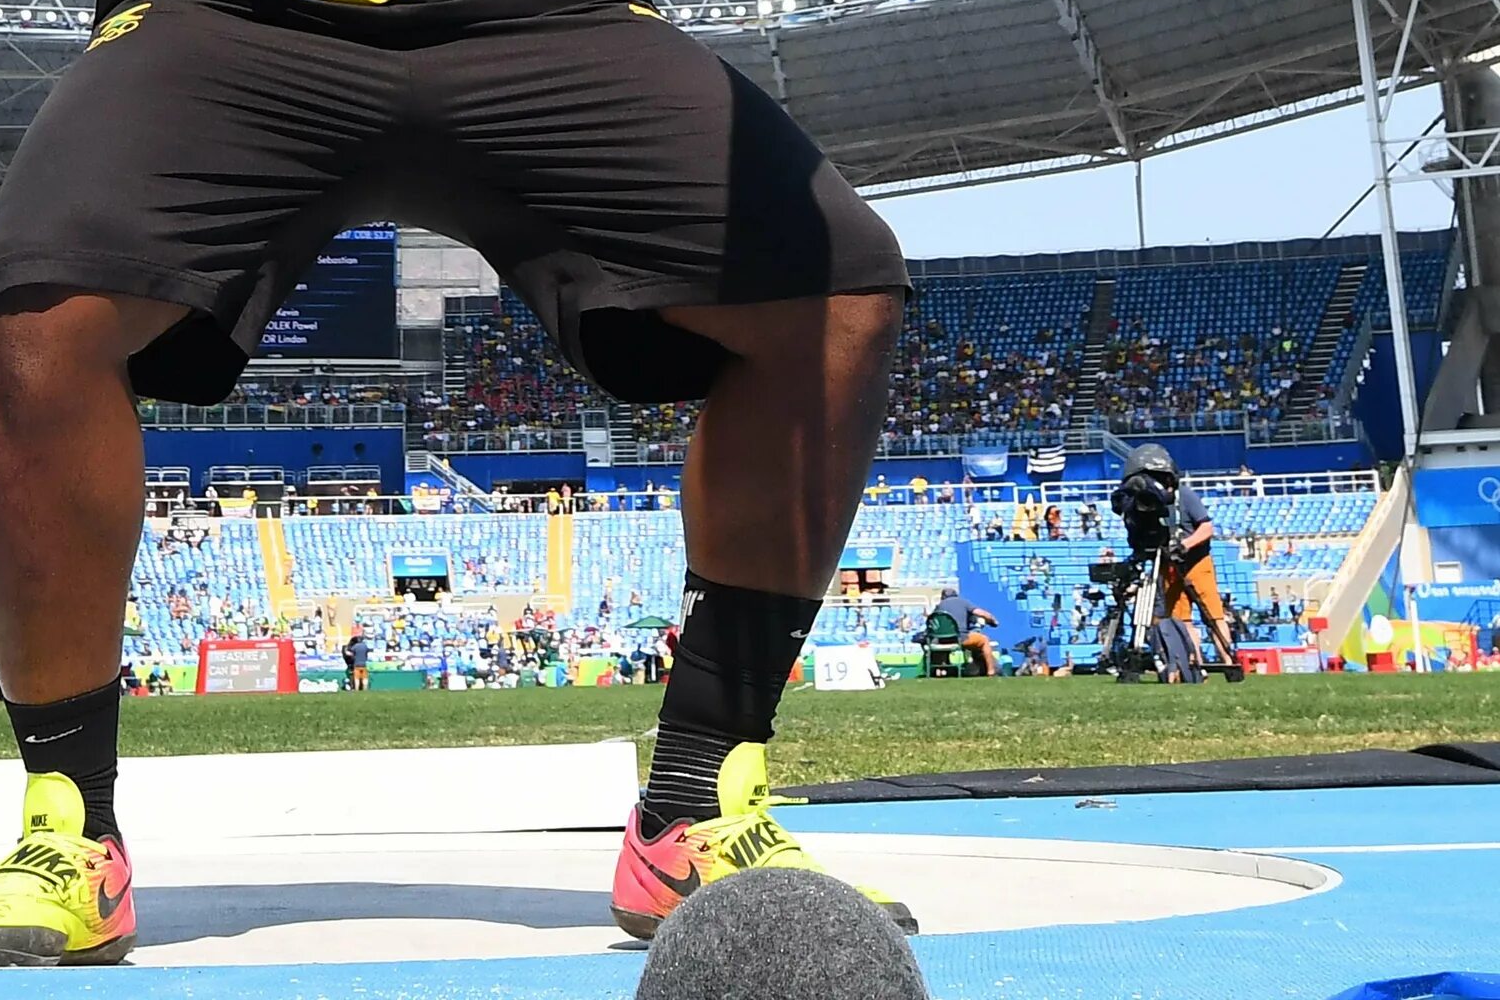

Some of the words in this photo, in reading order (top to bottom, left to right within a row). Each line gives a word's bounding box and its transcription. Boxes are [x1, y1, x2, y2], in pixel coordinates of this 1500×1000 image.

[316, 255, 358, 265] Sebastian
[277, 334, 307, 344] Lindon
[823, 661, 848, 682] 19
[31, 814, 48, 827] NIKE
[720, 820, 787, 868] NIKE
